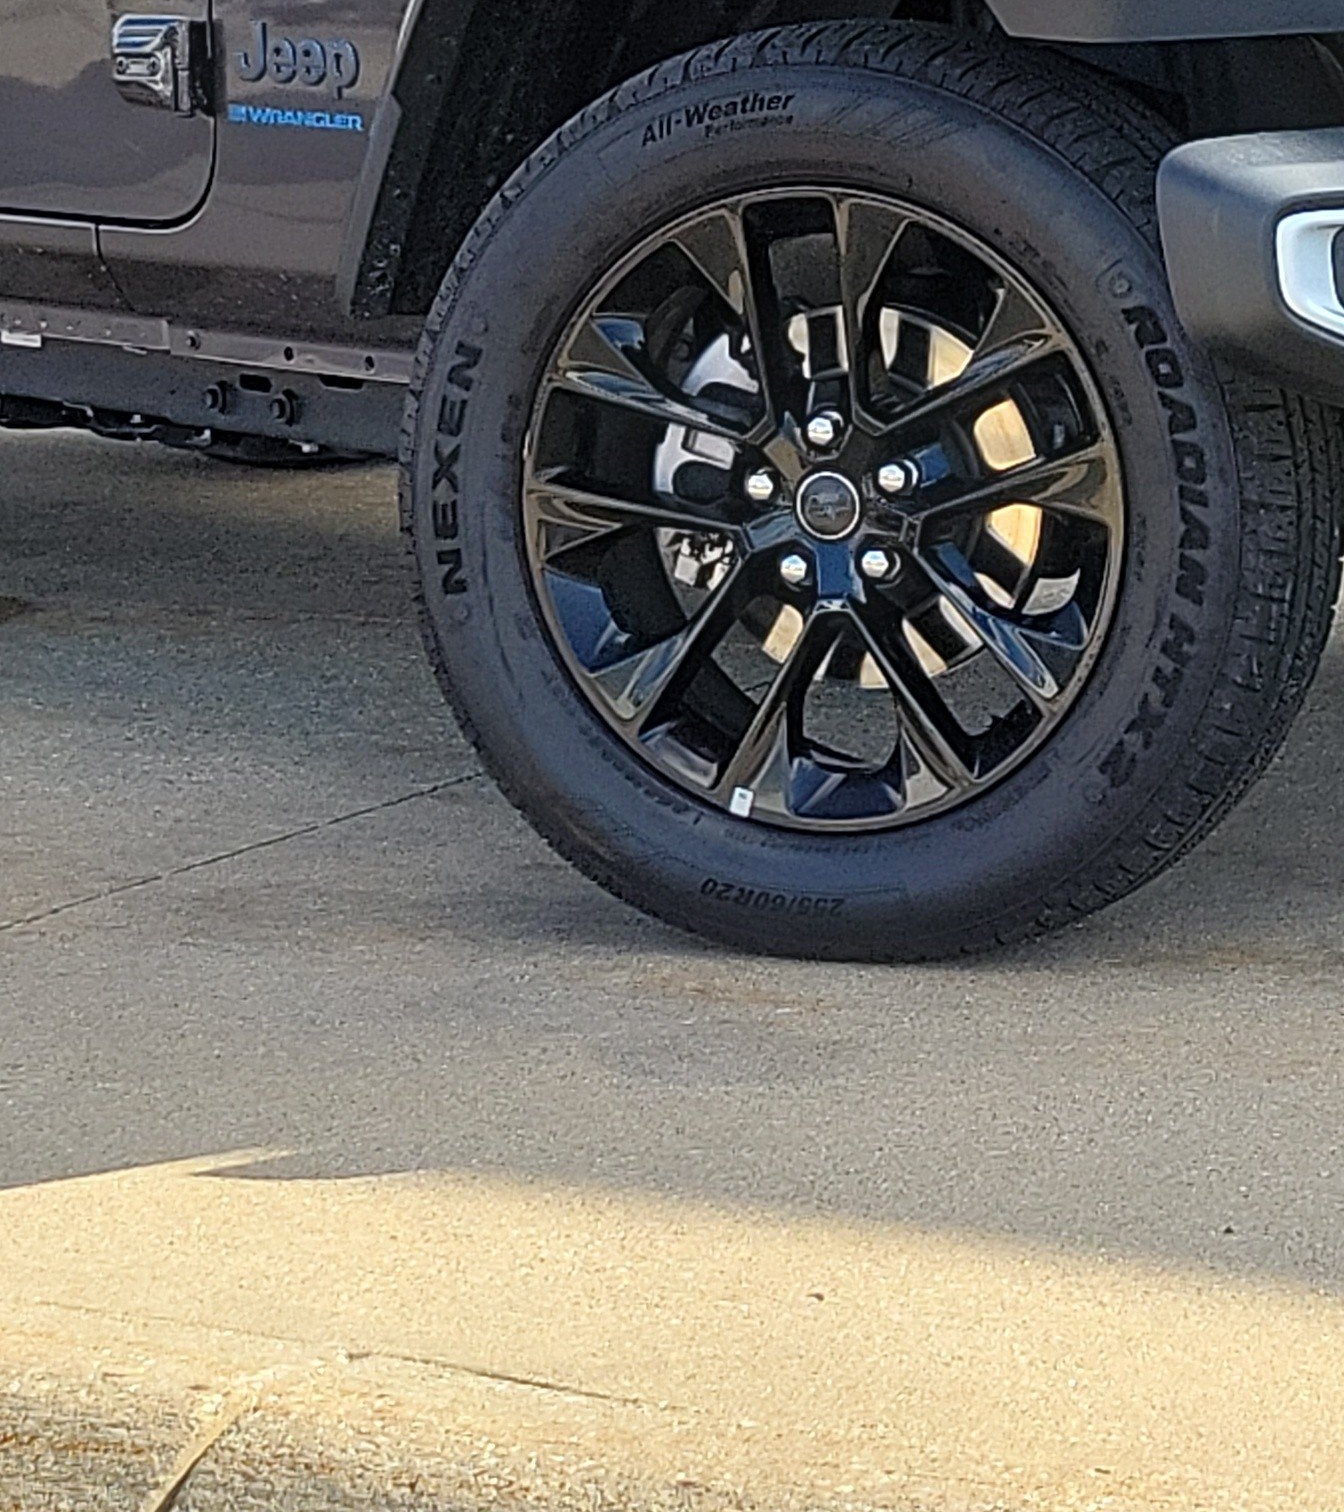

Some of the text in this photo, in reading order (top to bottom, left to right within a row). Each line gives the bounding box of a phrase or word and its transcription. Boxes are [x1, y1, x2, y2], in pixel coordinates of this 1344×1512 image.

[237, 20, 361, 100] Jeep
[642, 92, 795, 146] All-Weather
[432, 340, 483, 595] NEXEN
[1121, 305, 1211, 606] ROADIAN
[701, 878, 845, 917] 255/60R20
